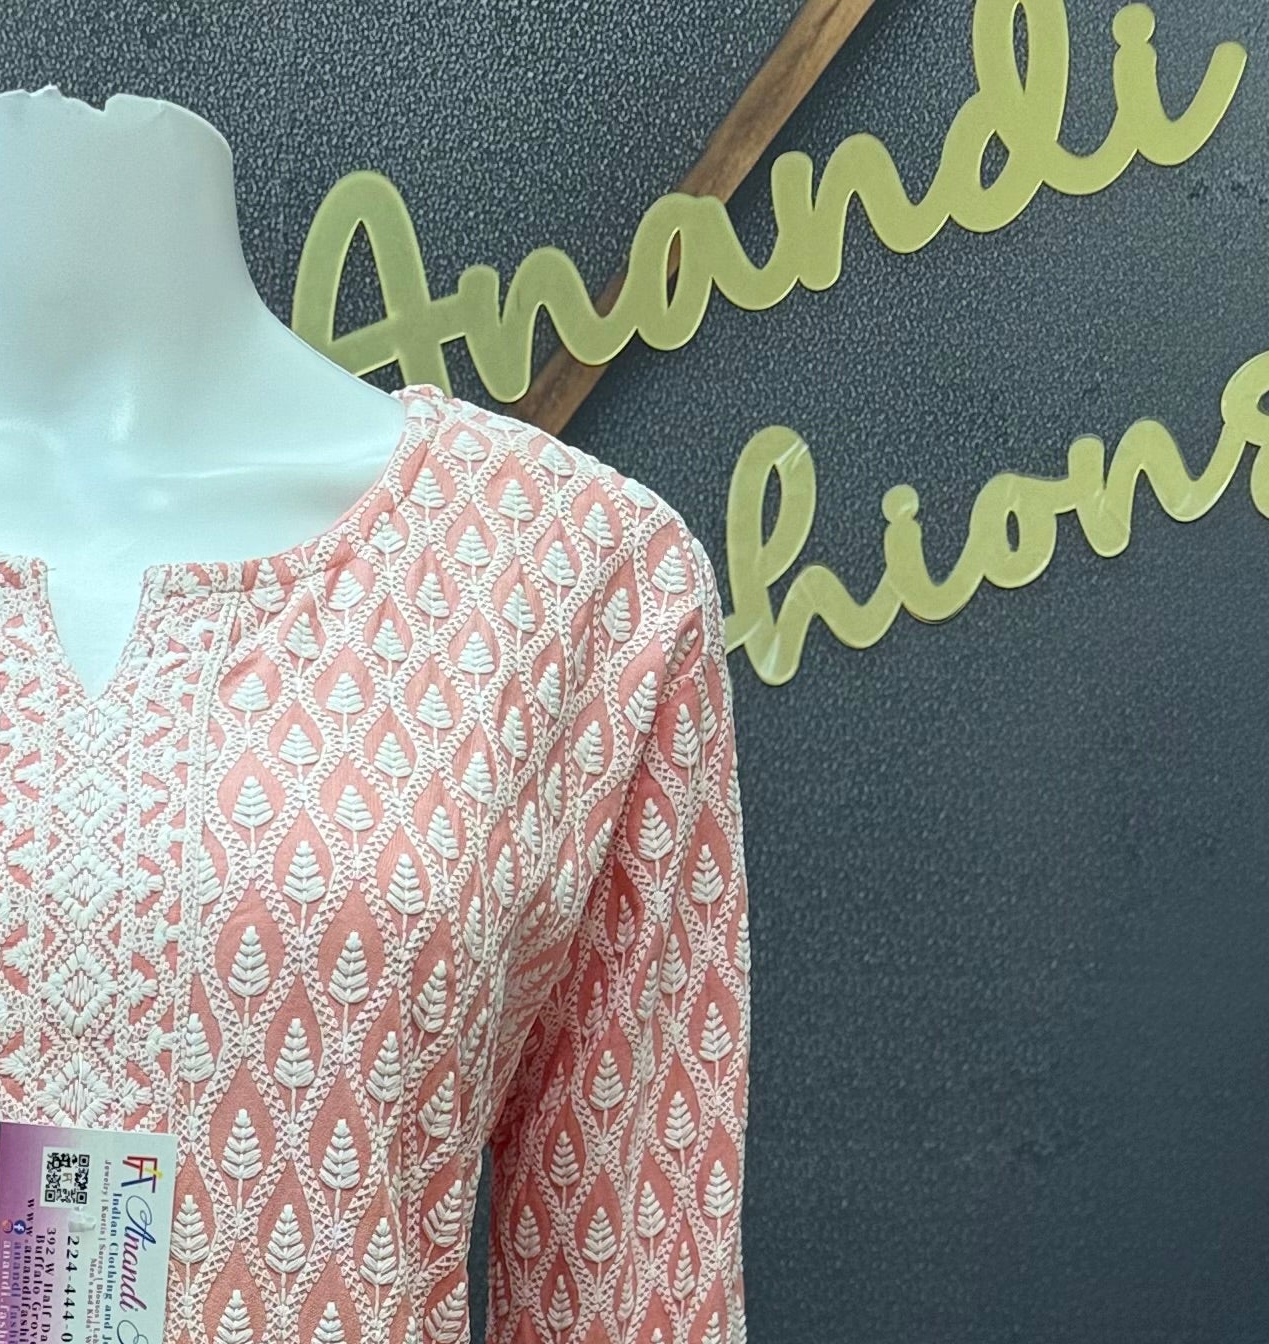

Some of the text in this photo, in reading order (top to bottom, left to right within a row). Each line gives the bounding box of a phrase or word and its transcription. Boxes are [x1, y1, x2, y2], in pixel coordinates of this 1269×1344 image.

[293, 0, 1247, 402] Anandi
[110, 1193, 122, 1237] Indian
[46, 1227, 56, 1255] 392
[119, 1195, 156, 1312] Anandi
[11, 1242, 21, 1297] anandi
[33, 1235, 46, 1294] Buffalo
[45, 1263, 55, 1276] W
[103, 1242, 120, 1300] Clothing
[42, 1284, 53, 1318] Half
[88, 1289, 96, 1305] and
[104, 1305, 113, 1329] and
